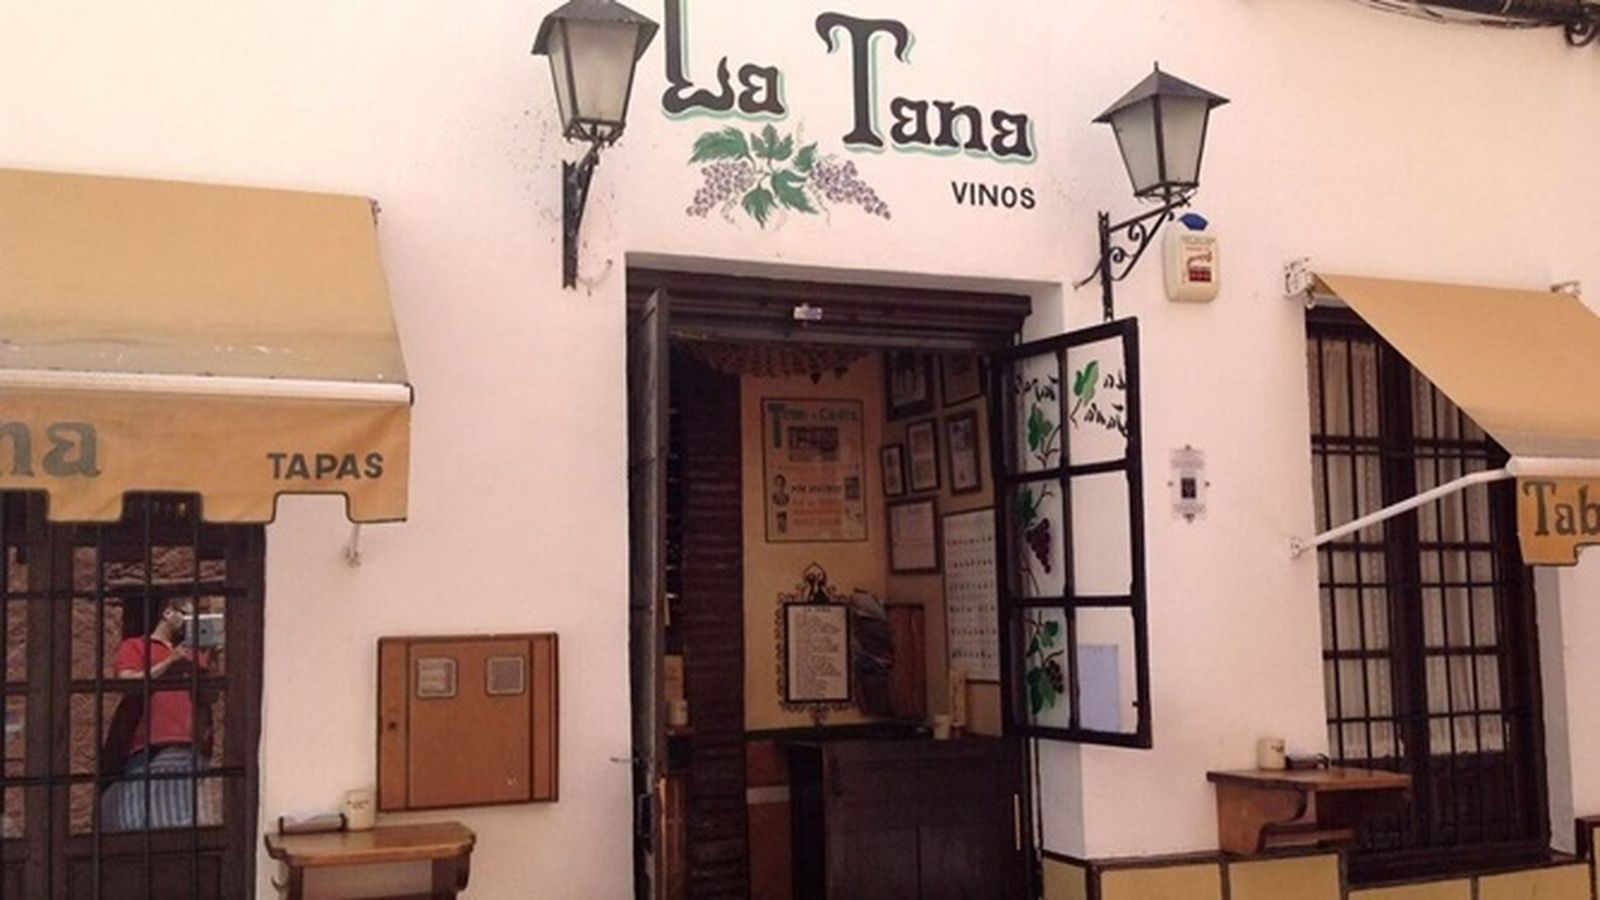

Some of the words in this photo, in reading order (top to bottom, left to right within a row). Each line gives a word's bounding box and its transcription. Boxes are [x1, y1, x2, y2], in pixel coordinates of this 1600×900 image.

[661, 0, 788, 120] La
[815, 11, 1039, 161] Tana
[950, 180, 1037, 210] VINOS
[267, 452, 385, 481] TAPAS
